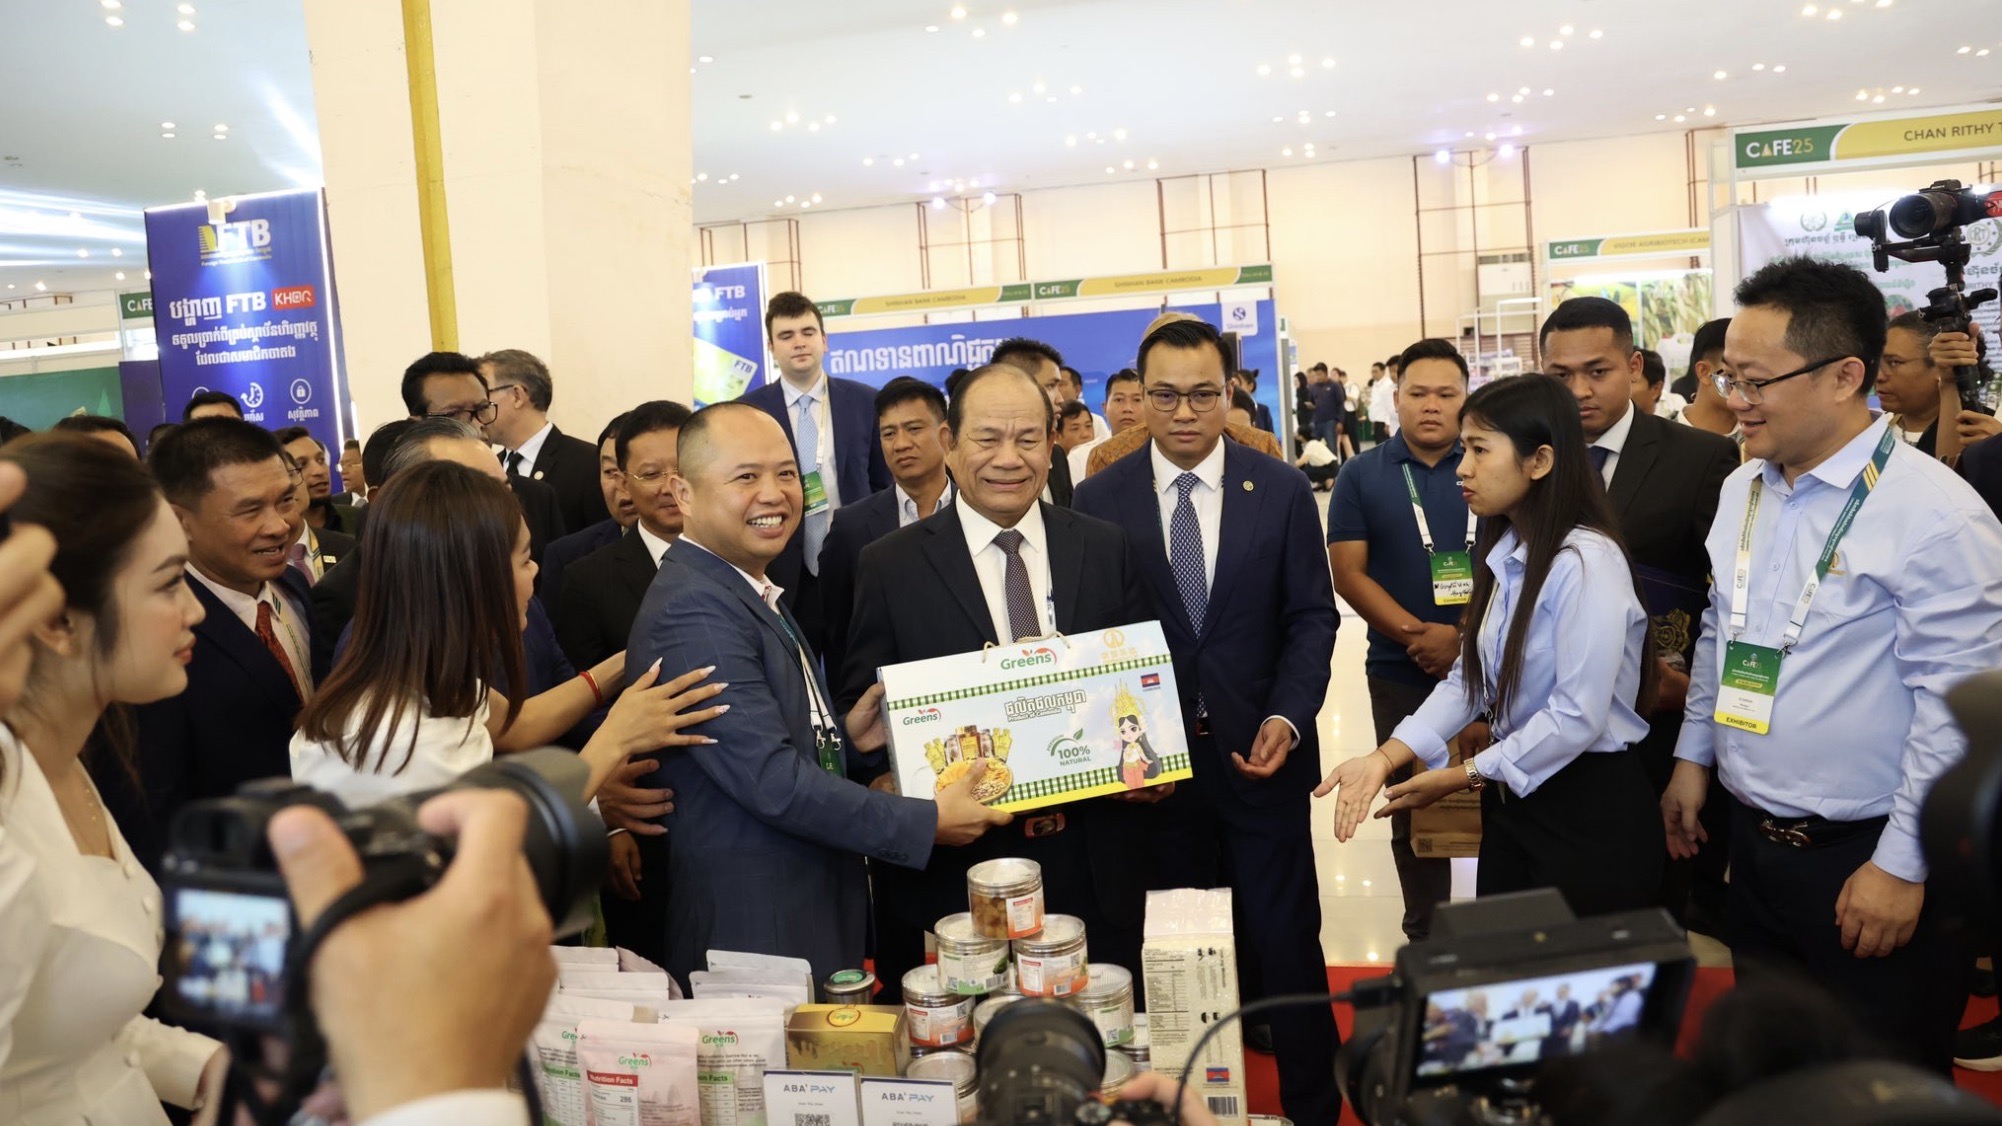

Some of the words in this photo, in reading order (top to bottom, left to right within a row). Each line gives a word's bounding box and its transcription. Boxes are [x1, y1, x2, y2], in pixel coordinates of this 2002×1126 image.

[1903, 127, 1946, 142] CHAN
[1952, 122, 1995, 137] RITHY
[1745, 137, 1814, 158] CAFE25
[216, 218, 271, 251] FTB
[714, 285, 746, 300] FTB
[169, 296, 223, 326] បង្ហាញ
[225, 290, 267, 314] FTB
[829, 334, 1010, 374] ឥណទានពាណិជ្ជក
[734, 360, 753, 374] FTB
[1000, 651, 1052, 671] Greens
[902, 711, 939, 726] Greens
[1726, 716, 1757, 730] EXHIBITOR
[1057, 744, 1091, 760] 100%
[1059, 756, 1092, 767] NATURAL
[702, 1034, 736, 1044] Greens
[618, 1055, 649, 1067] Greens
[589, 1073, 615, 1084] Nutrition
[616, 1076, 633, 1085] Facts
[709, 1074, 728, 1082] Facts
[810, 1085, 836, 1094] PAY
[908, 1093, 935, 1102] PAY
